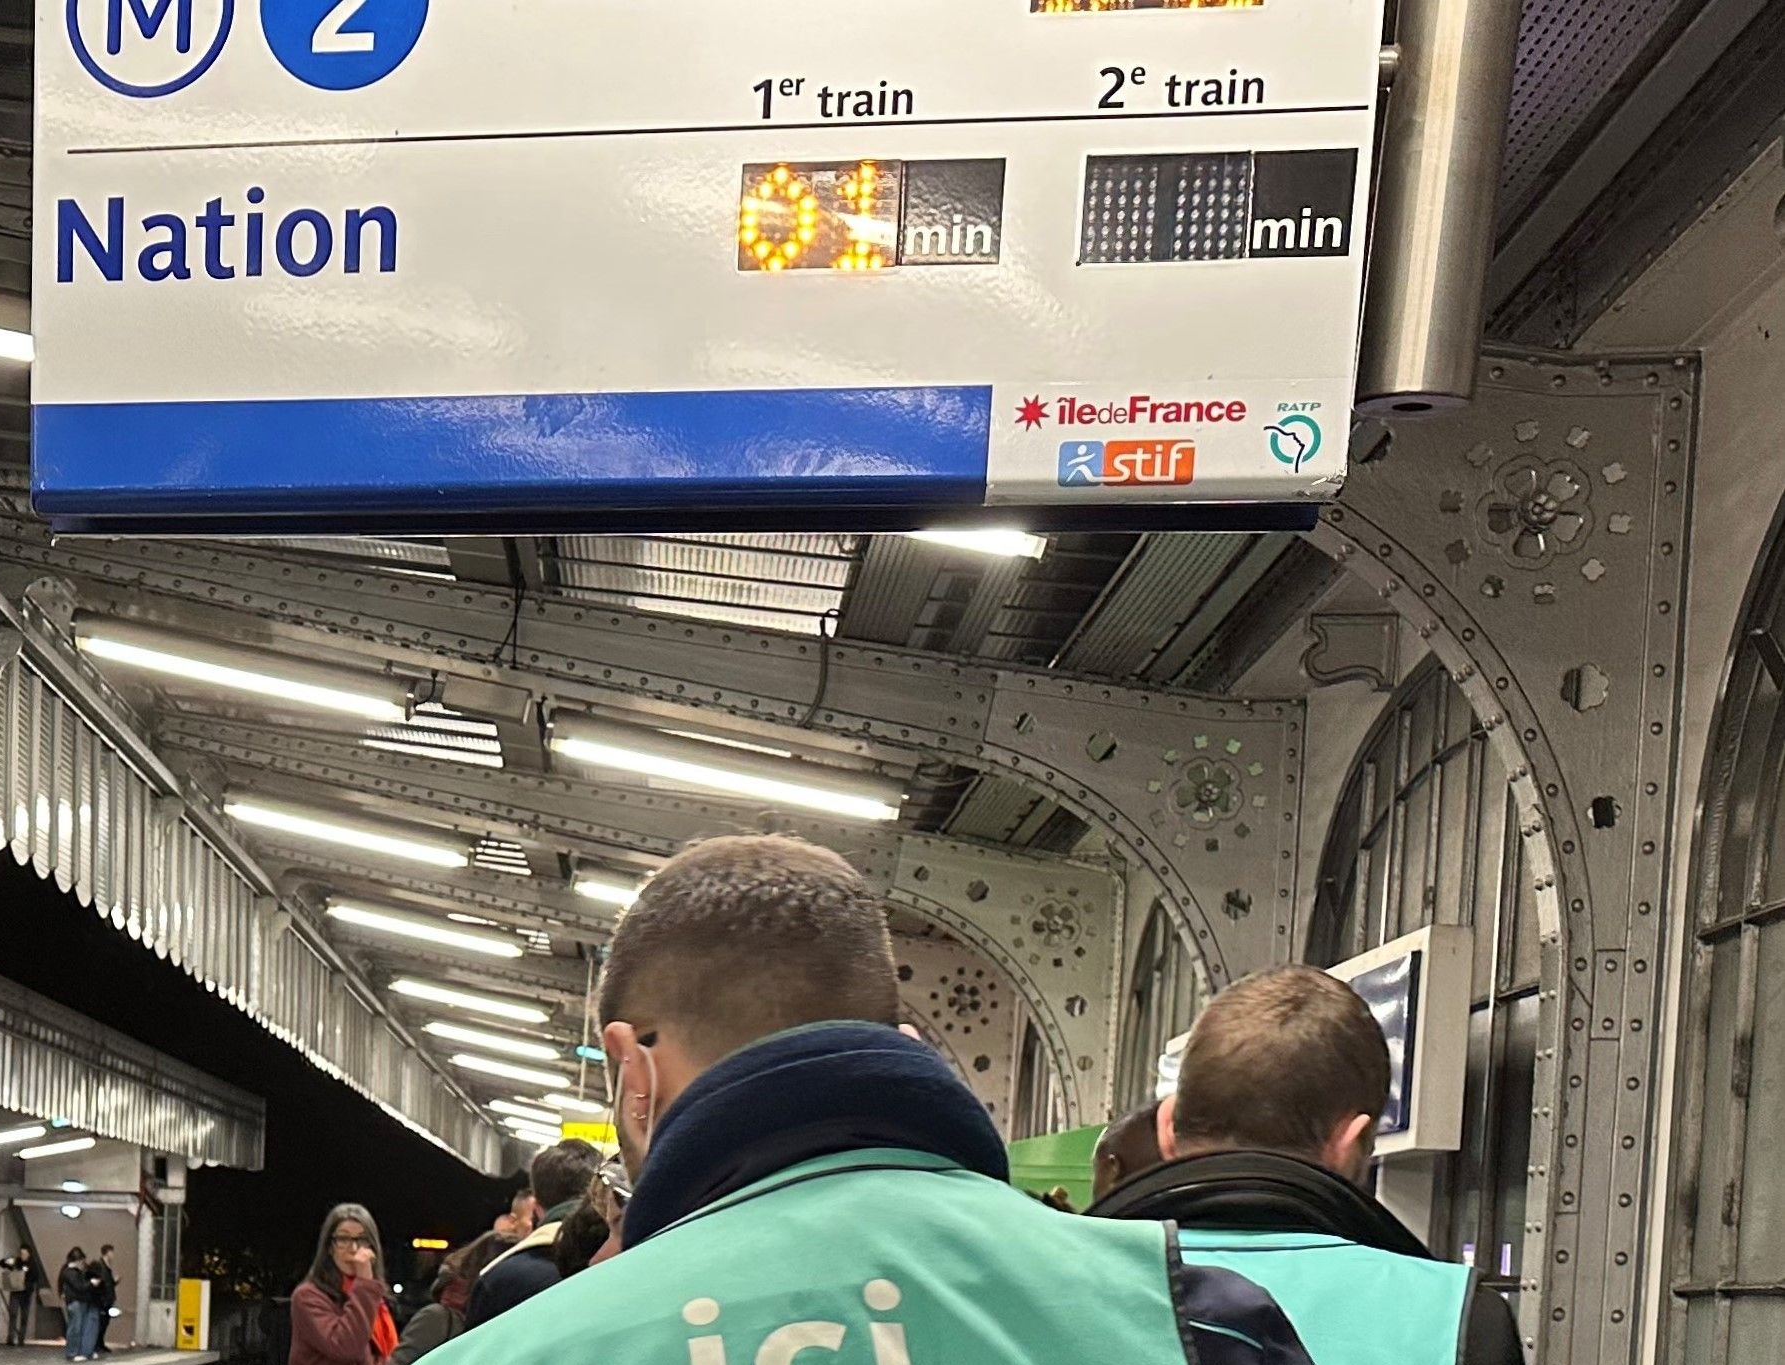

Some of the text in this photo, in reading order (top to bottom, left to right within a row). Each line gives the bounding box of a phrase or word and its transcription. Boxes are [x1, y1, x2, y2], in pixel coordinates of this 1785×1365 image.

[817, 81, 914, 118] train
[1165, 70, 1266, 108] train
[56, 186, 398, 283] Nation
[905, 213, 994, 258] min
[1252, 207, 1343, 251] min
[1276, 401, 1322, 413] RATP
[1113, 442, 1196, 483] stif
